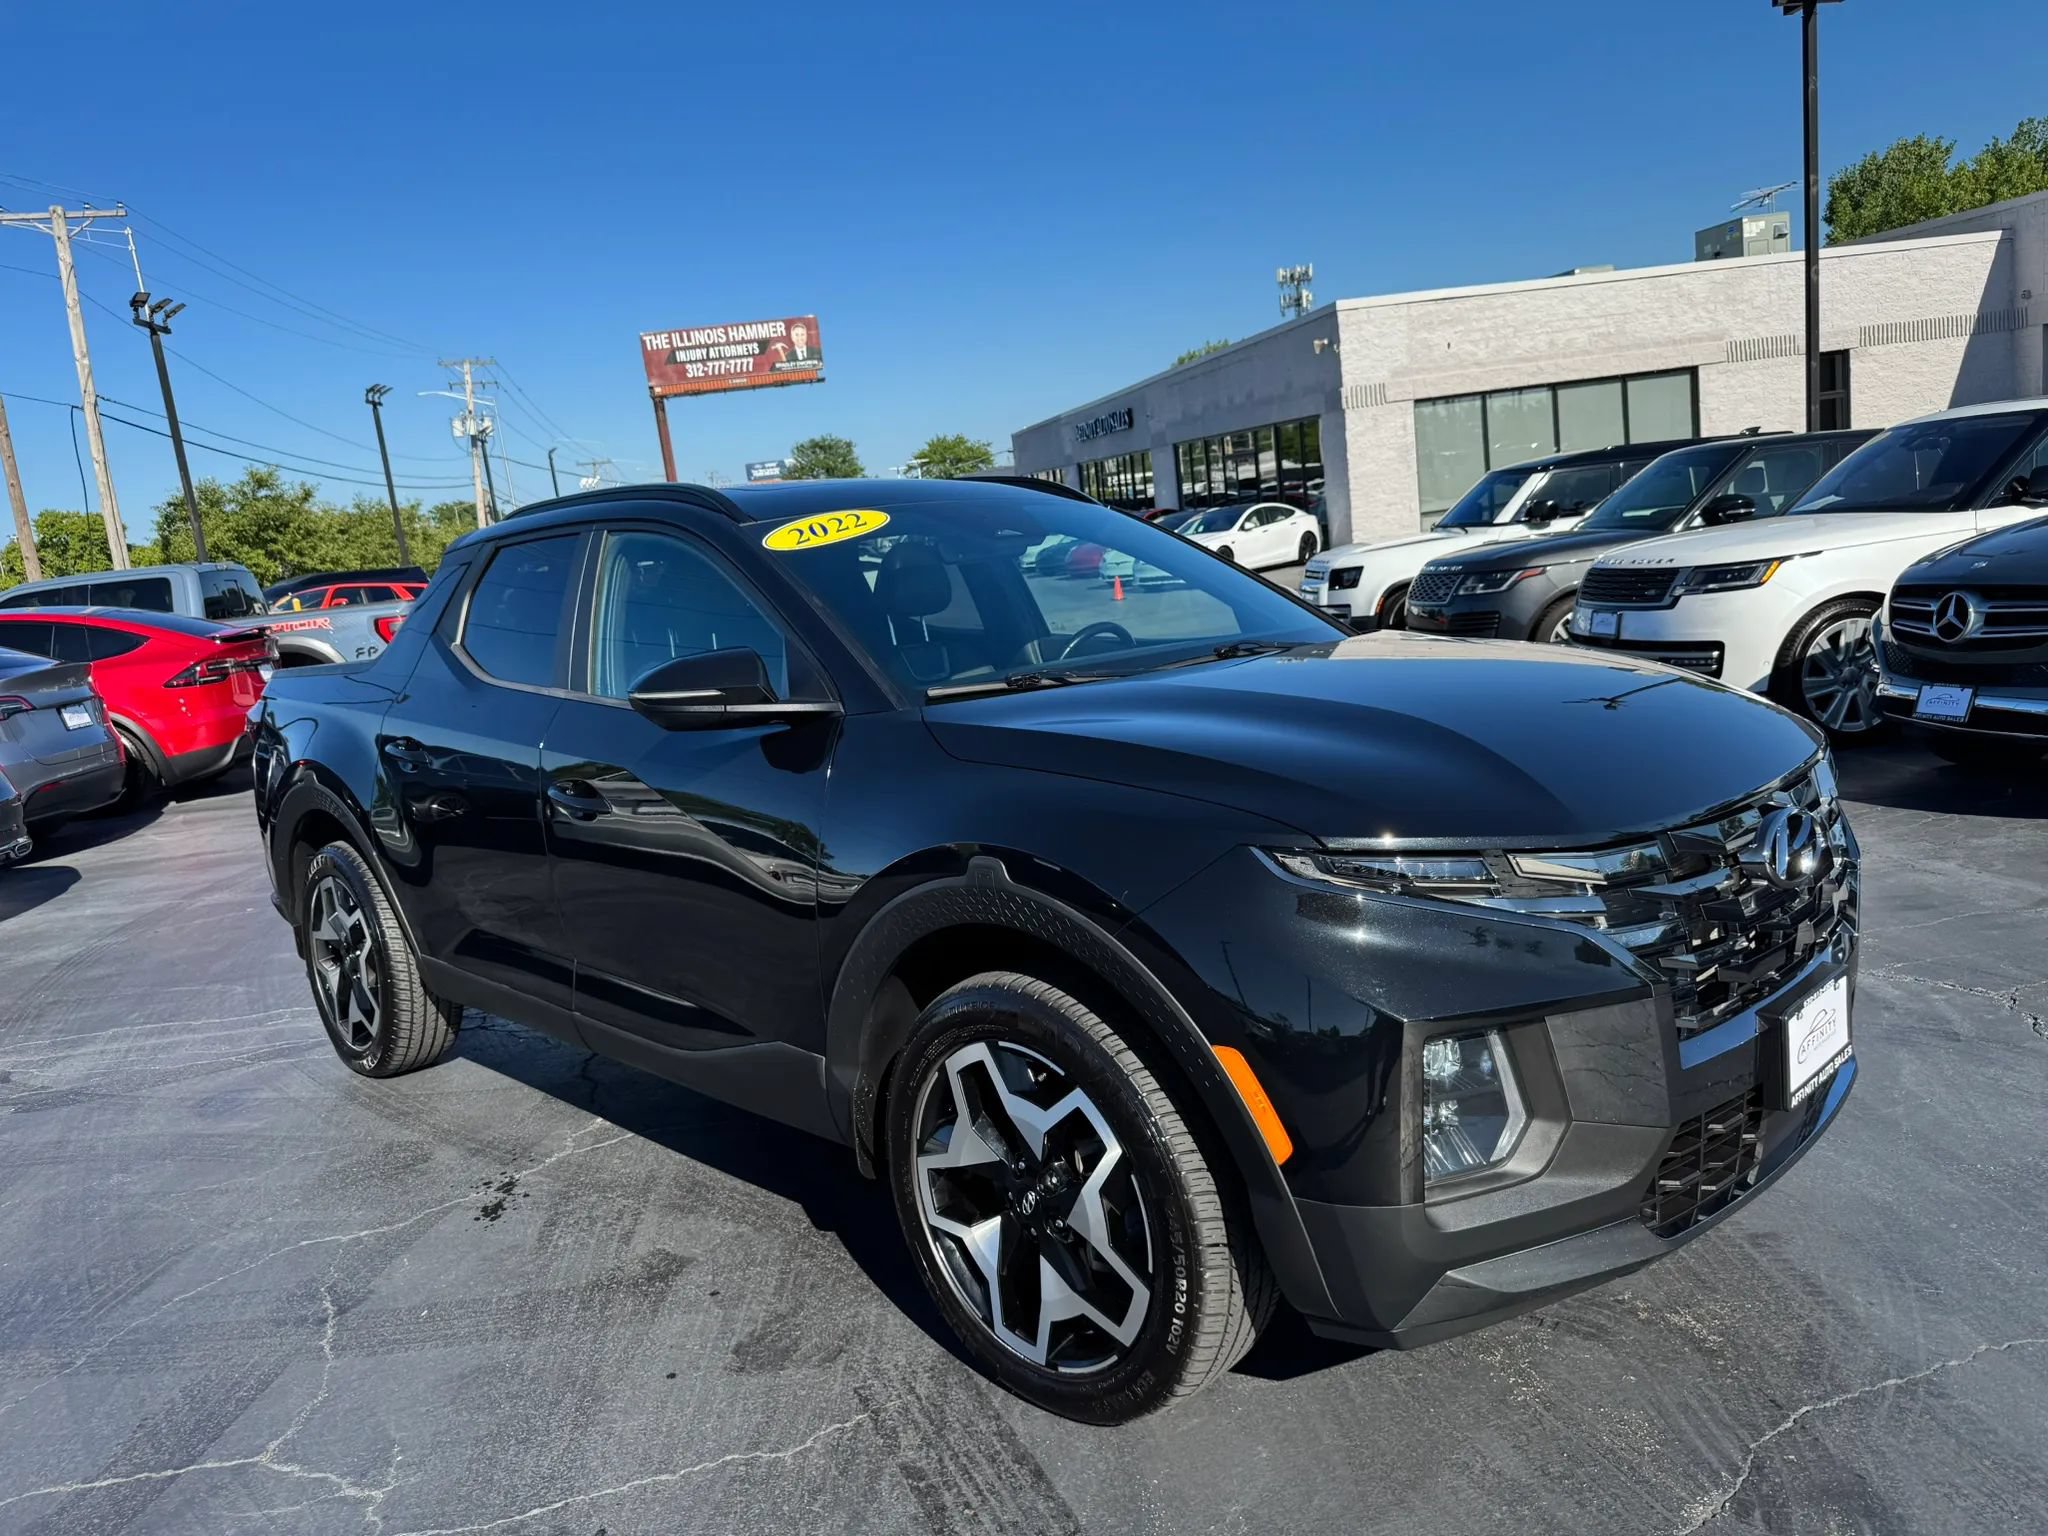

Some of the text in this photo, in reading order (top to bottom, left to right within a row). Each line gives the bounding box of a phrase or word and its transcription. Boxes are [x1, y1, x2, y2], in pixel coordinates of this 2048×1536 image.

[643, 321, 786, 351] THE ILLINOIS HAMMER
[675, 342, 760, 363] INJURY ATTORNEYS
[685, 358, 754, 378] 312-777-7777
[787, 513, 867, 545] 2022
[1928, 699, 1959, 707] AFFINITY
[1800, 1017, 1836, 1053] AFFINITY
[1791, 1045, 1852, 1109] AFFINITY AUTO SALES
[1166, 1316, 1185, 1355] 102V
